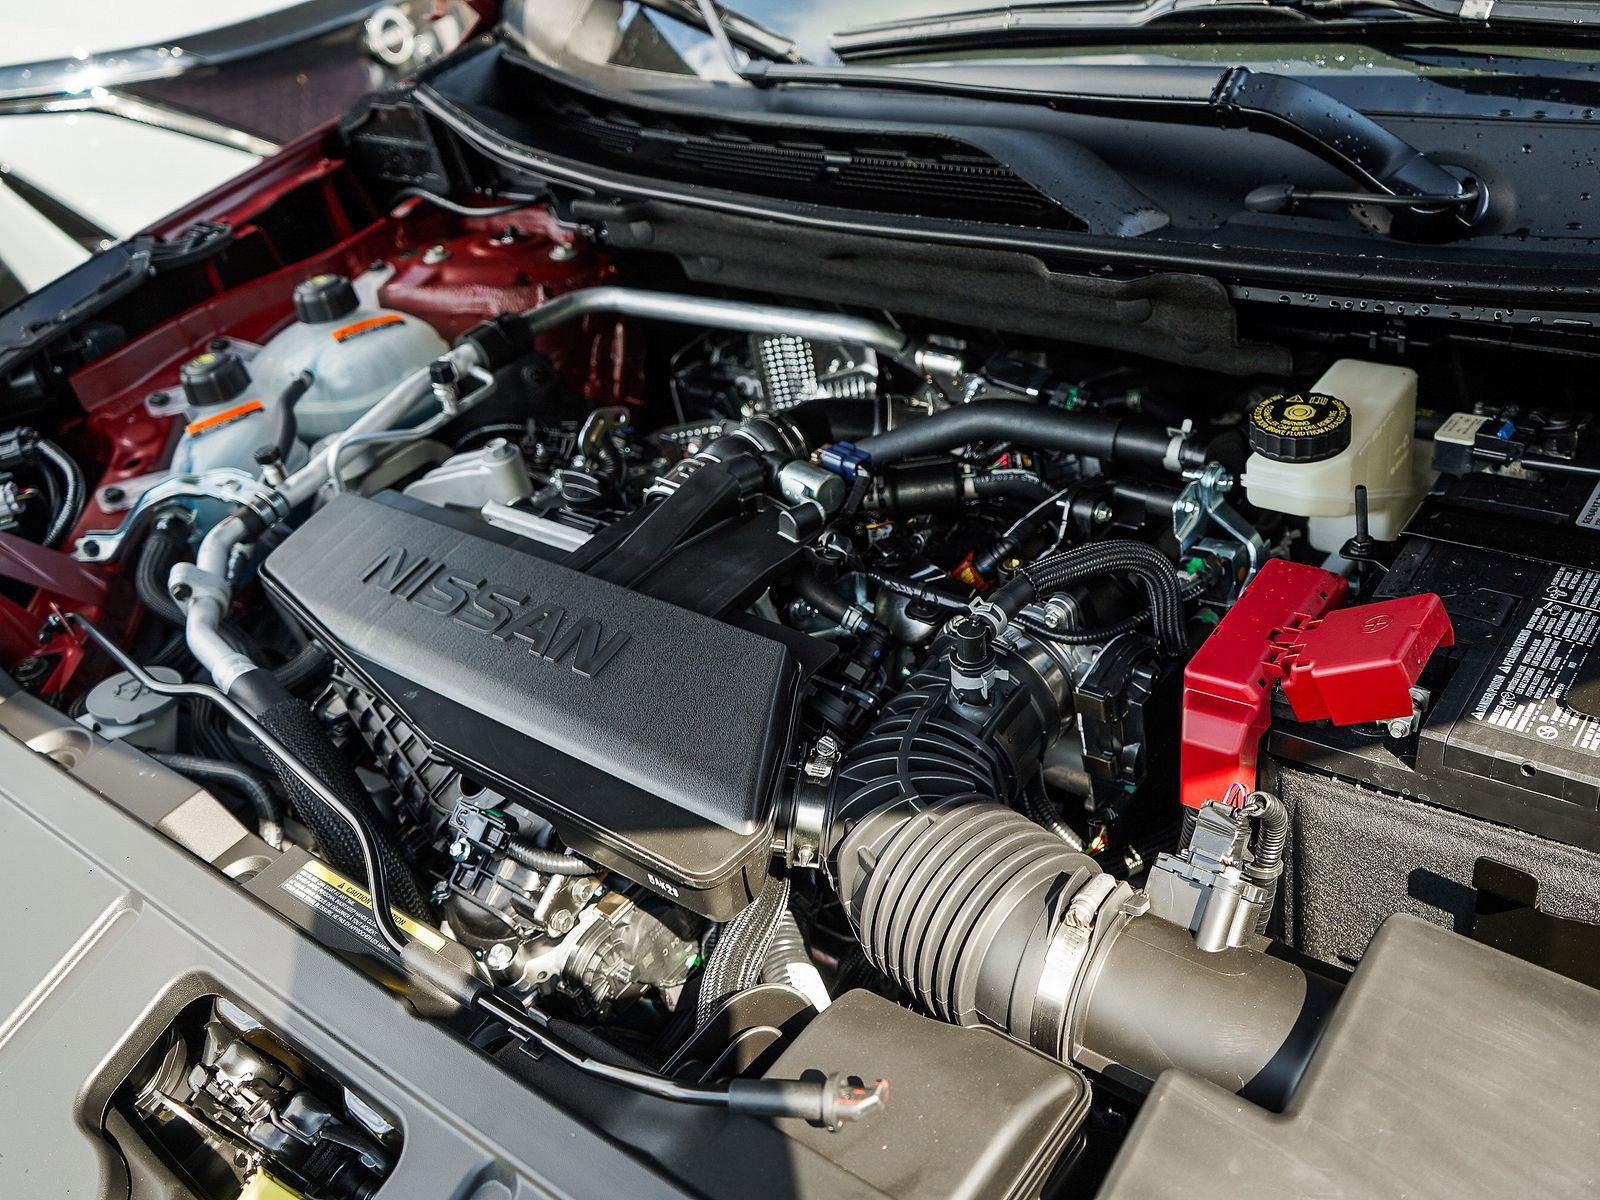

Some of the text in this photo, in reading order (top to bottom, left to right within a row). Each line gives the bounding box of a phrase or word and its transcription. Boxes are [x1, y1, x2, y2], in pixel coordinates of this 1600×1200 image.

[1306, 427, 1325, 437] FROM
[360, 545, 632, 678] NISSAN
[345, 886, 371, 904] CAUTION
[354, 911, 368, 921] HANDS
[349, 924, 372, 940] APPROCHER
